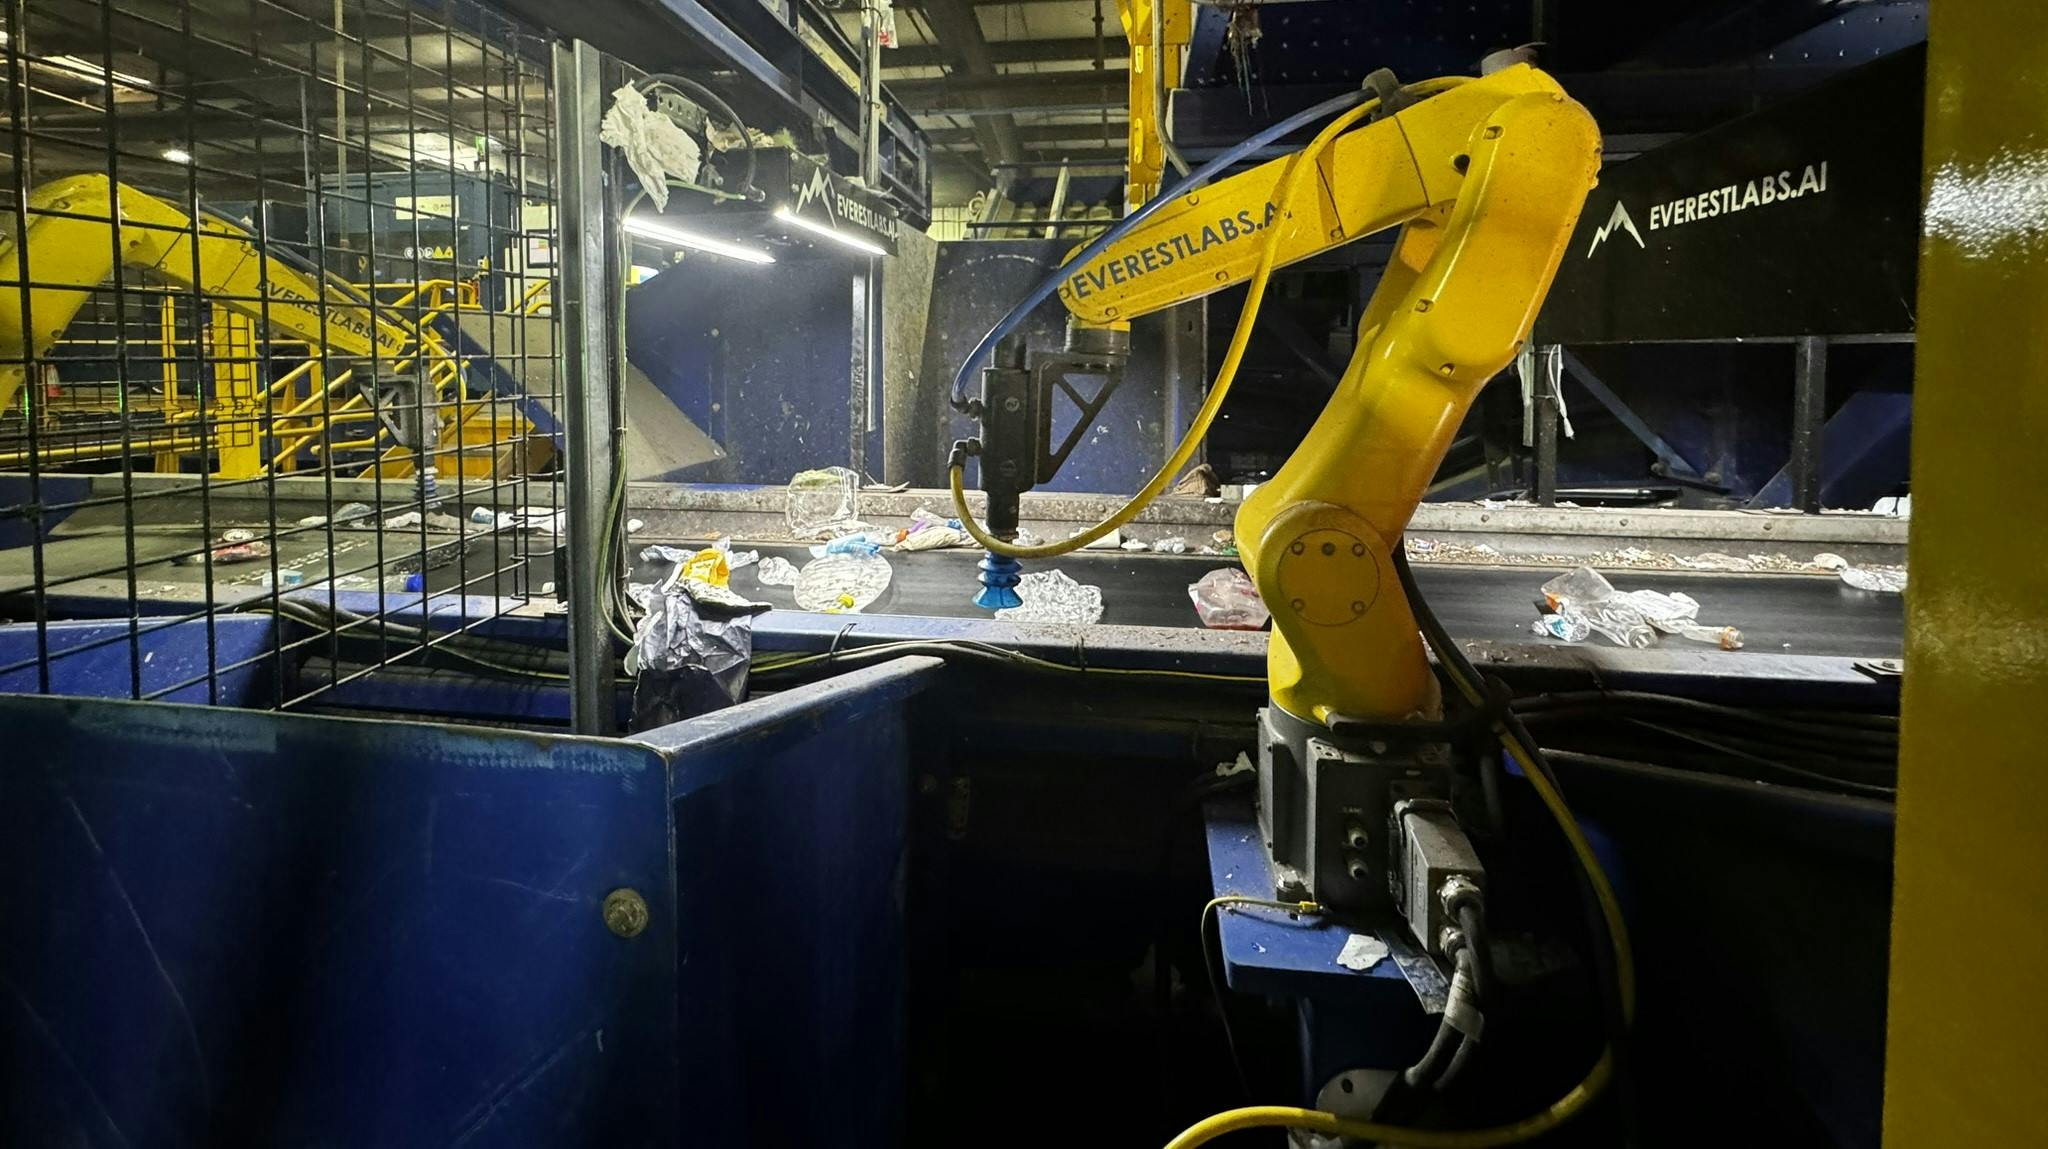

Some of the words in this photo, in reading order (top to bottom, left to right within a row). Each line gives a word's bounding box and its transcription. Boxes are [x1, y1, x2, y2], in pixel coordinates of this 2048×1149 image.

[837, 193, 896, 242] EVERESTLABS.AI
[1650, 161, 1828, 231] EVERESTLABS.AI
[1072, 201, 1292, 299] EVERESTLABS.A
[255, 279, 394, 349] EVERESTLABSAI
